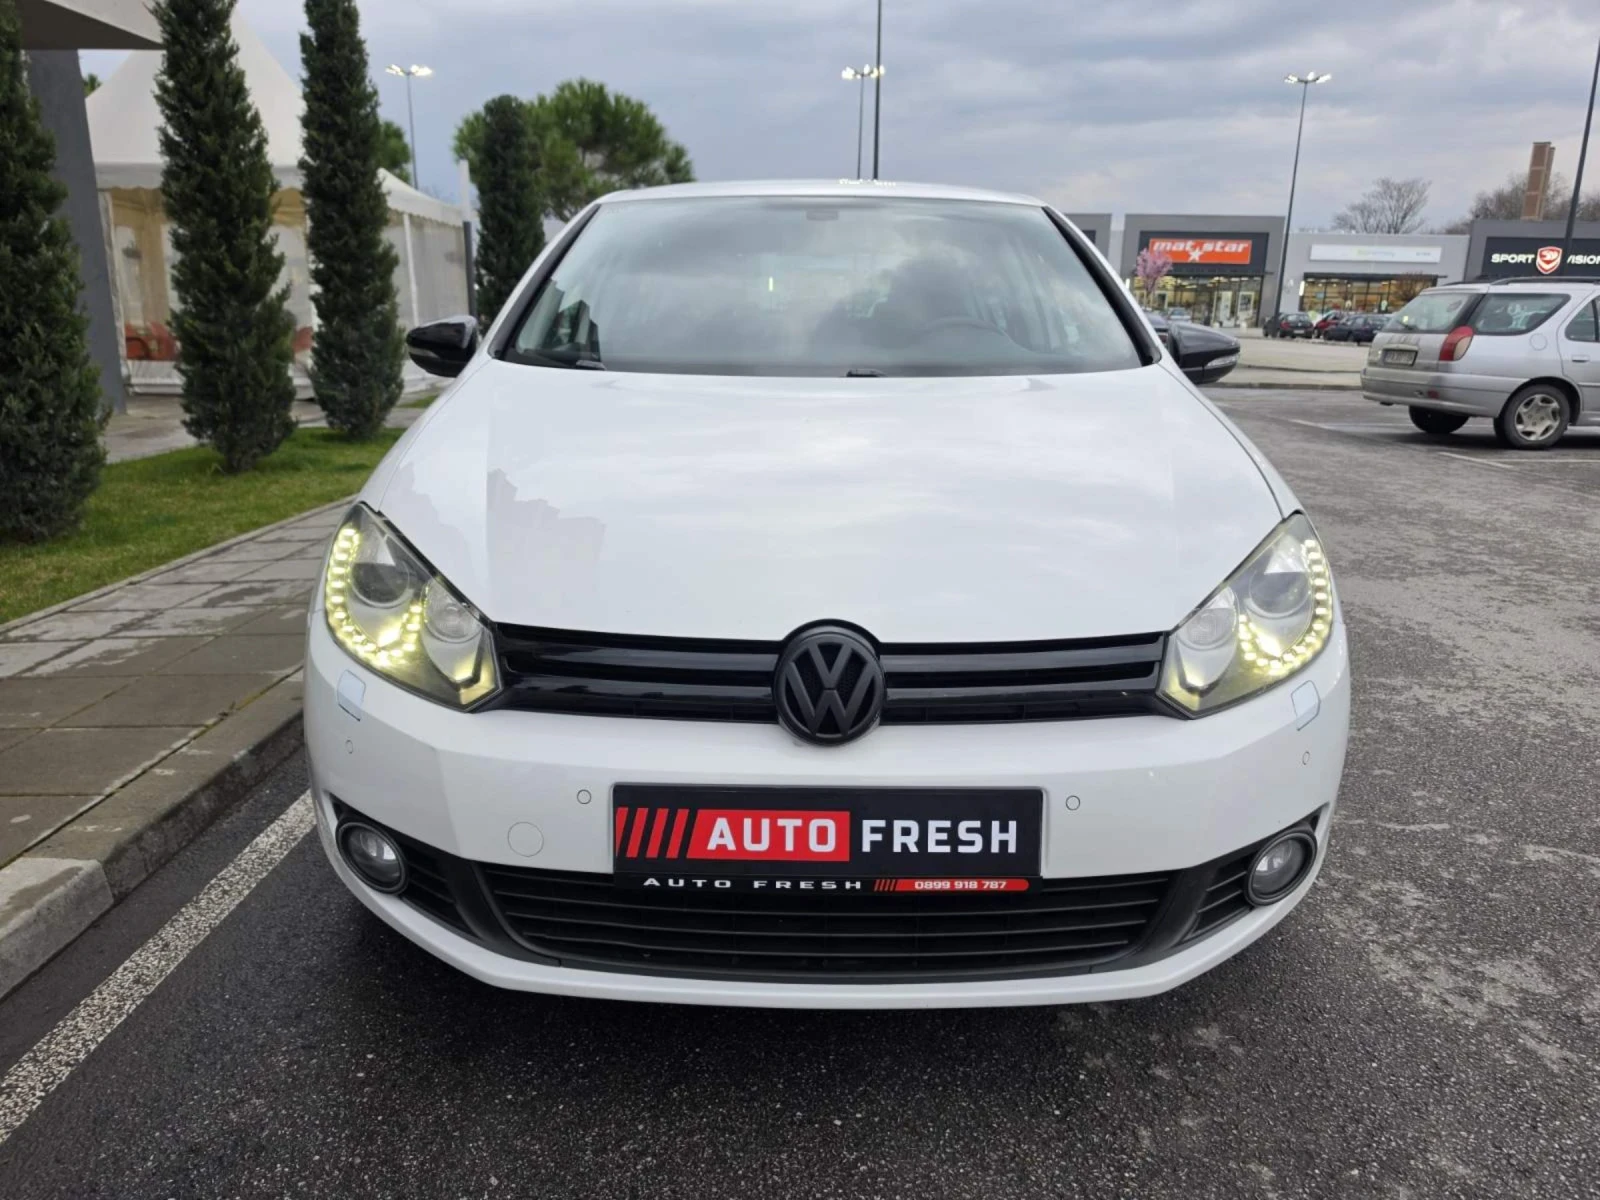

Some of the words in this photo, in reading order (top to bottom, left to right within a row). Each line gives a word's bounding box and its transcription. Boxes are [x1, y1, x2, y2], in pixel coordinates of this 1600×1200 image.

[1153, 240, 1193, 252] mat
[1202, 240, 1249, 253] star
[1491, 253, 1535, 264] SPORT
[706, 817, 836, 853] AUTO
[861, 819, 1017, 854] FRESH
[643, 877, 732, 888] AUTO
[753, 880, 861, 890] FRESH
[914, 880, 950, 890] 0899
[954, 880, 978, 890] 918
[982, 880, 1007, 890] 787
